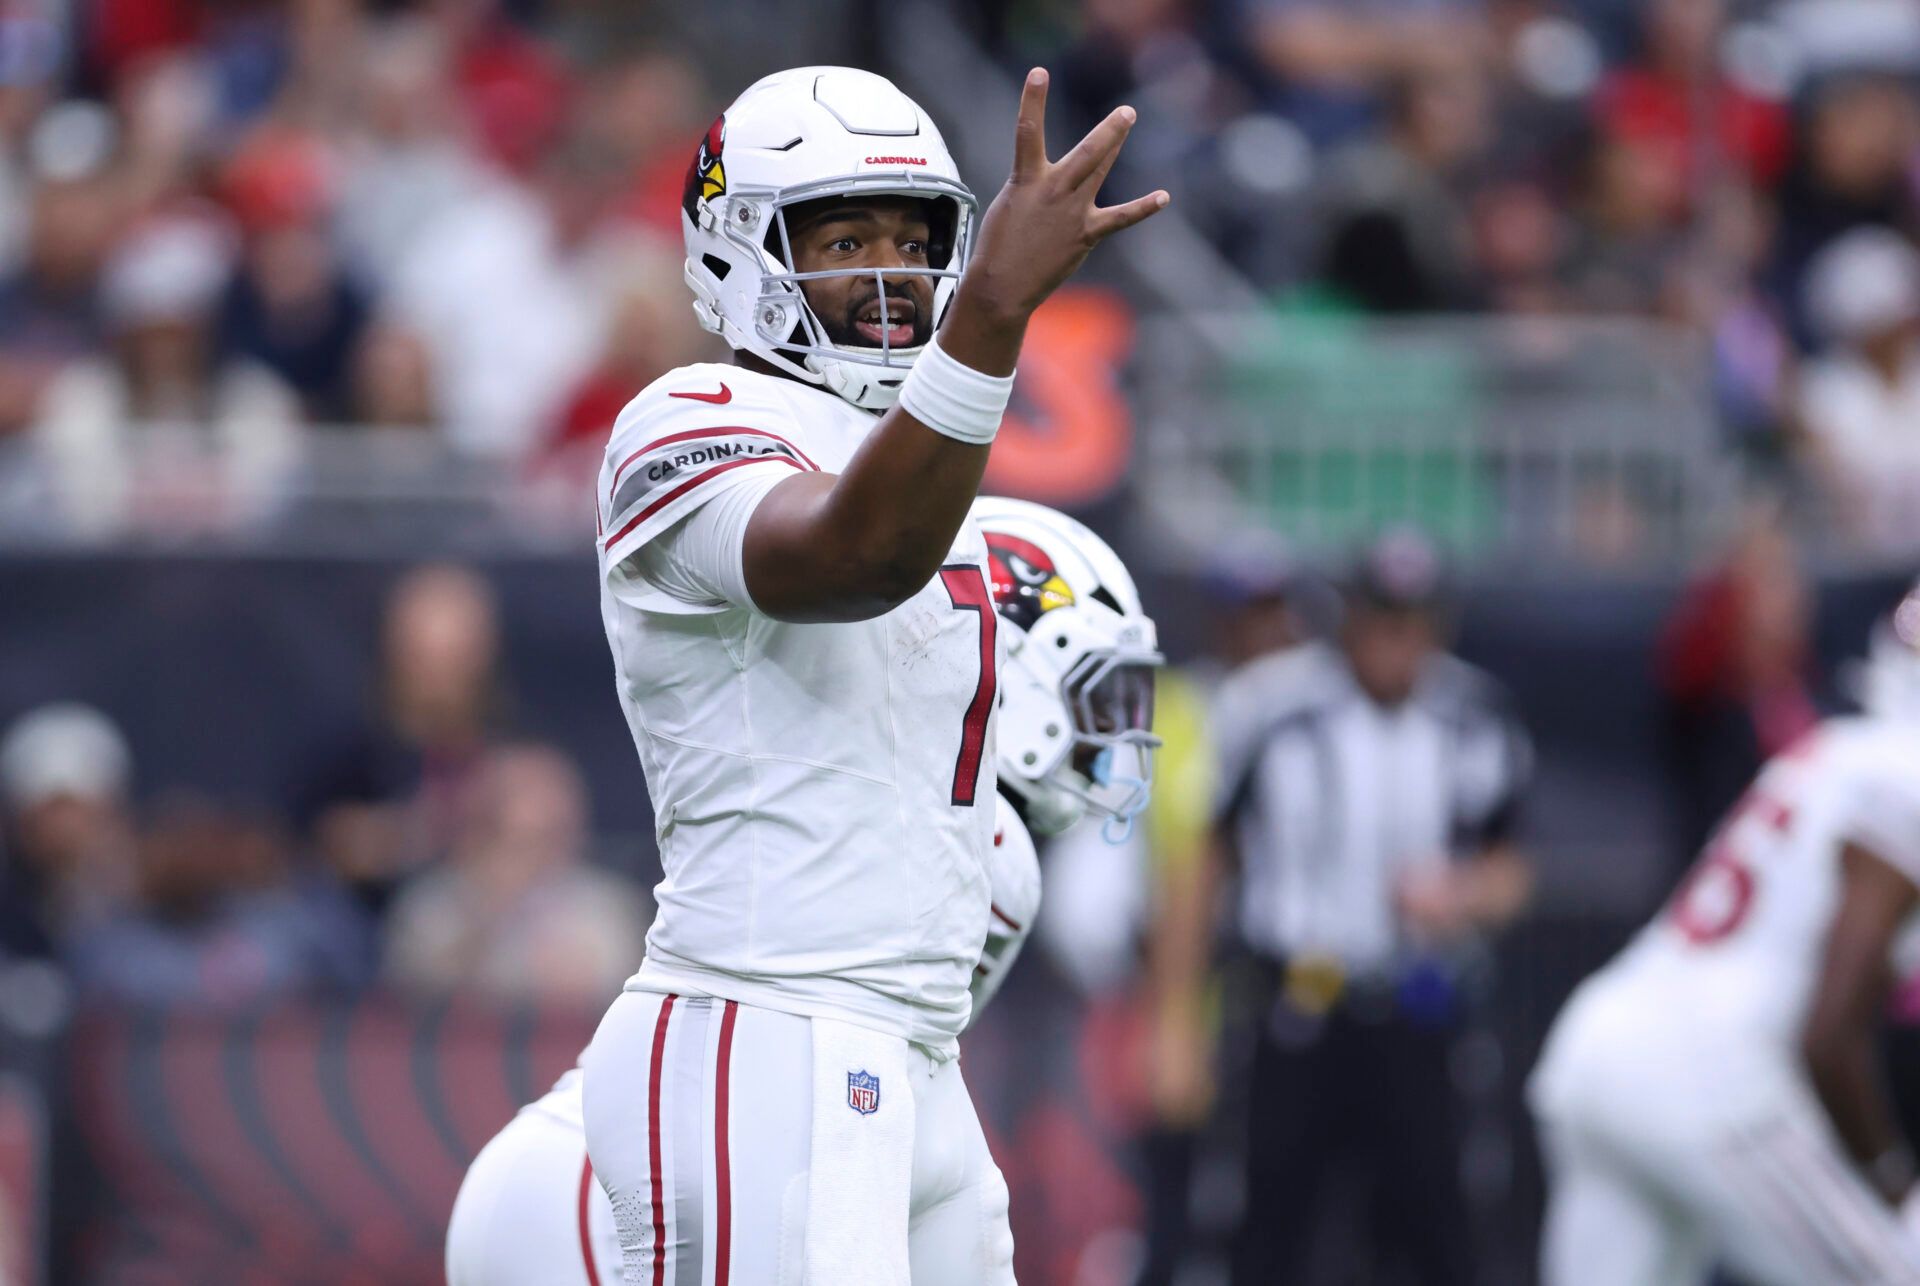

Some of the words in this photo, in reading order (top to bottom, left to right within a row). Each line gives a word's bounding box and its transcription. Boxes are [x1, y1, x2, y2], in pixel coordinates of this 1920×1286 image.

[864, 156, 927, 166] CARDINALS
[940, 564, 997, 806] 7
[852, 1088, 876, 1110] NFL
